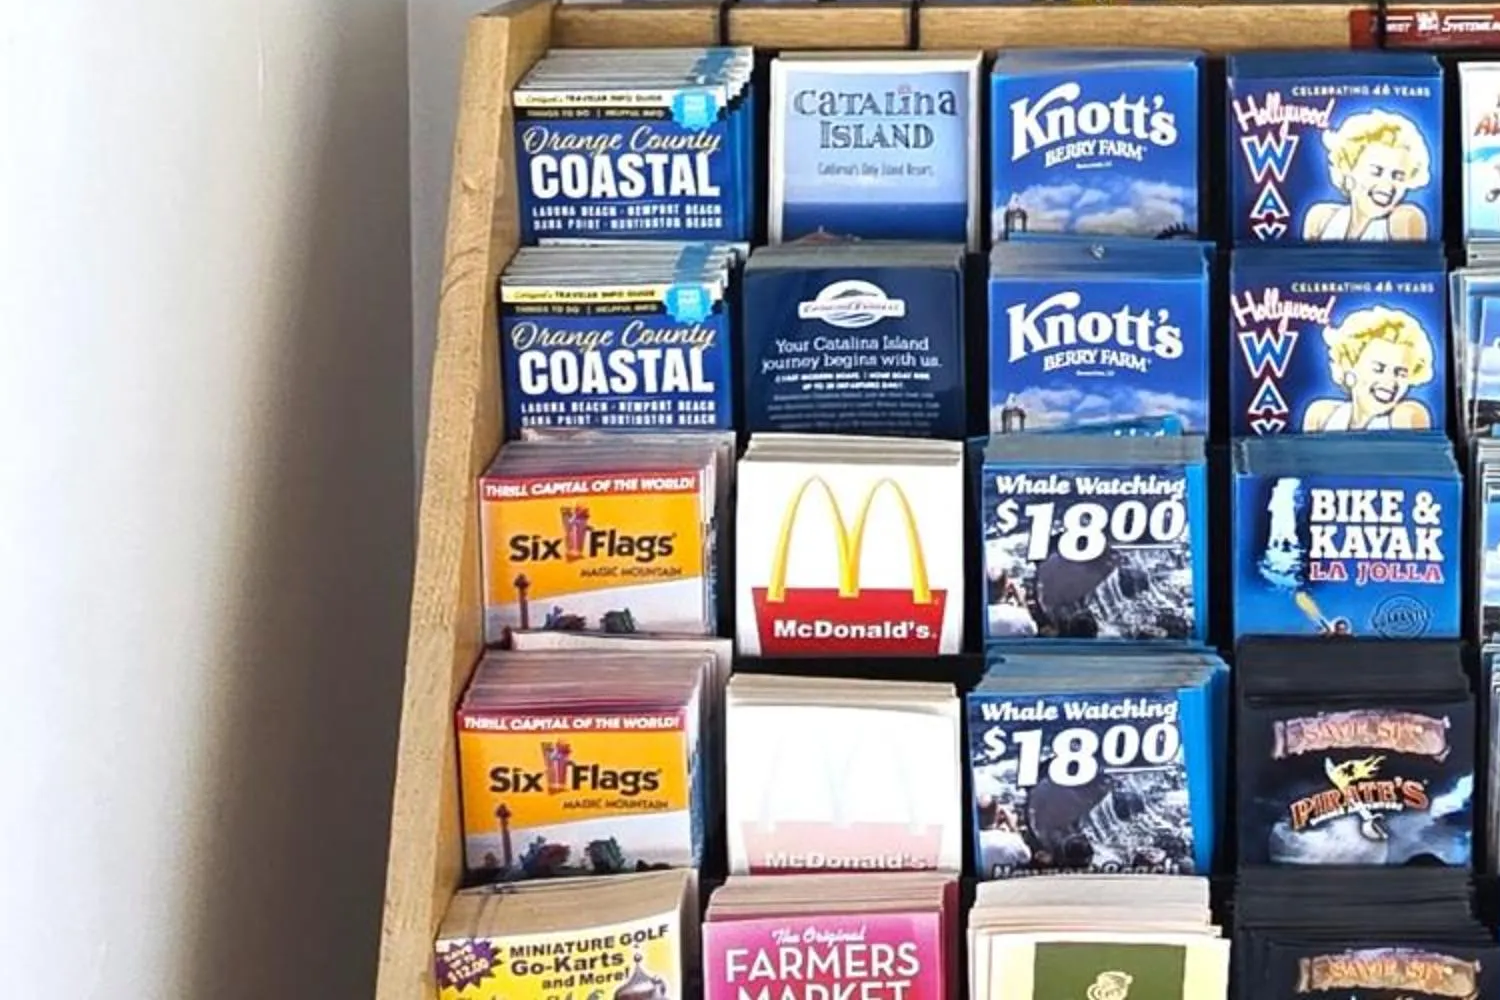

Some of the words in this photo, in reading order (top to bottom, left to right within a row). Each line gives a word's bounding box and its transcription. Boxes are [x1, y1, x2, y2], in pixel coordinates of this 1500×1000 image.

[1292, 86, 1369, 97] CELEBRATING
[1395, 87, 1431, 97] YEARS
[1010, 82, 1177, 161] Knott's
[1233, 92, 1335, 139] Hollywood
[523, 126, 623, 158] Orange
[630, 126, 721, 154] County
[819, 120, 935, 149] ISLAND
[1045, 140, 1097, 168] BERRY
[1099, 139, 1143, 161] FARM
[530, 153, 721, 198] COASTAL
[1291, 282, 1371, 292] CELEBRATING
[1231, 287, 1336, 333] Hollywood
[511, 321, 614, 353] Orange
[621, 320, 716, 349] County
[776, 339, 809, 354] Your
[813, 337, 879, 351] Catalina
[883, 335, 929, 350] Island
[518, 348, 715, 395] COASTAL
[762, 354, 820, 374] journey
[824, 353, 877, 368] begins
[881, 353, 916, 366] with
[920, 354, 942, 367] us.
[485, 483, 528, 496] THRILL
[531, 480, 589, 495] CAPITAL
[592, 480, 610, 491] OF
[614, 479, 638, 490] THE
[641, 476, 695, 489] WORLD!
[995, 474, 1071, 495] Whale
[1075, 474, 1186, 499] Watching
[1310, 489, 1404, 523] BIKE
[1412, 491, 1441, 525] &
[509, 534, 562, 561] Six
[589, 529, 674, 563] Flags
[1310, 525, 1444, 561] KAYAK
[581, 567, 618, 577] MAGIC
[621, 566, 682, 576] MOUNTAIN
[1310, 561, 1347, 581] LA
[1356, 561, 1444, 586] JOLLA
[773, 619, 930, 639] McDonald's
[981, 701, 1059, 721] Whale
[1063, 699, 1178, 724] Watching
[489, 766, 544, 793] Six
[571, 764, 659, 795] Flags
[764, 853, 927, 869] McDonald's
[510, 935, 615, 958] MINIATURE
[620, 924, 669, 945] GOLF
[772, 929, 800, 945] The
[803, 925, 866, 946] Original
[511, 951, 625, 976] Go-Karts
[725, 943, 920, 982] FARMERS
[542, 976, 575, 989] and
[578, 969, 630, 986] More!
[737, 980, 911, 1000] MARKET
